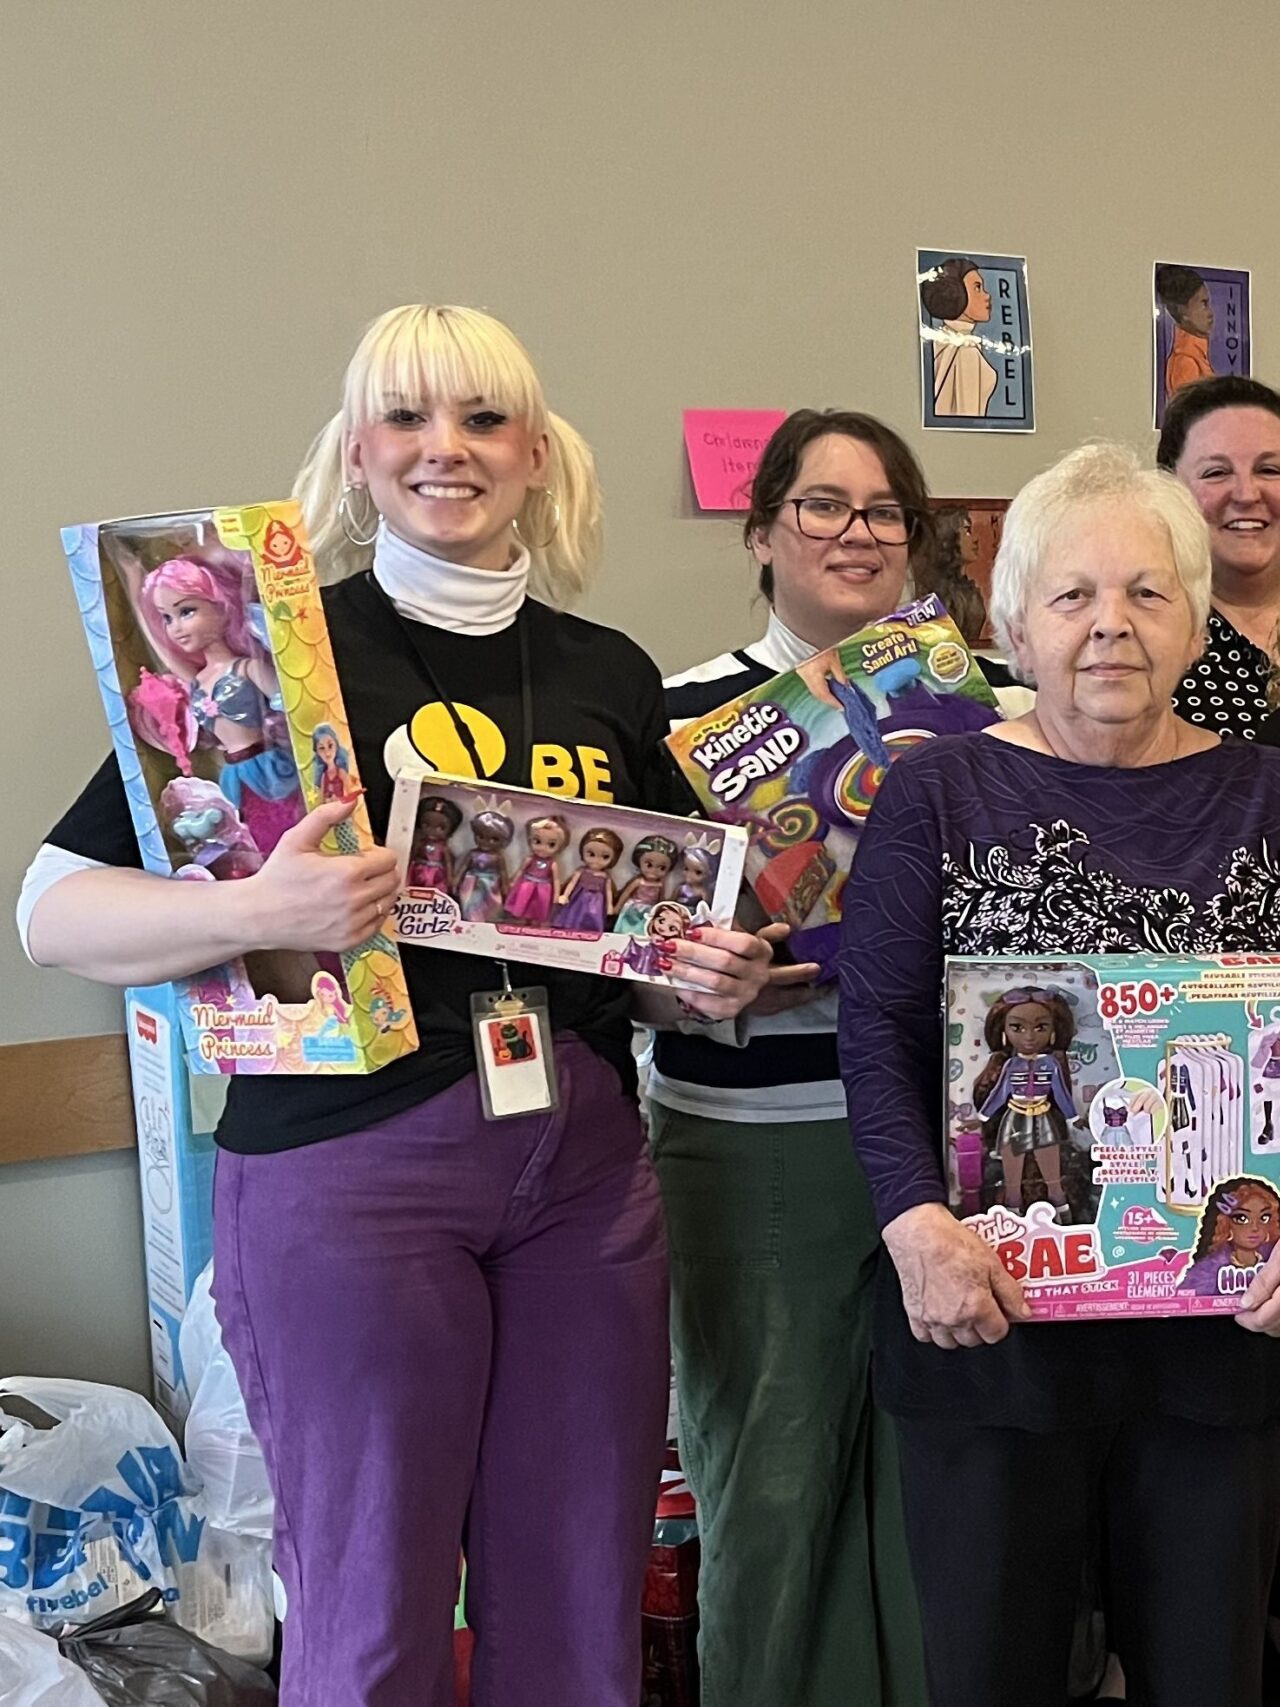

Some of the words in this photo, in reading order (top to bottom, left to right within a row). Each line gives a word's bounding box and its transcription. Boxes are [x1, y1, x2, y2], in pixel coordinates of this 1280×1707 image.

[998, 278, 1016, 406] REBEL
[861, 633, 905, 658] Create
[861, 650, 894, 674] Sand
[693, 705, 779, 770] Kinetic
[531, 744, 613, 804] BE
[1100, 982, 1175, 1018] 850+
[193, 1002, 276, 1028] Mermaid
[201, 1033, 274, 1061] Princess
[1127, 1211, 1153, 1225] 15+
[997, 1233, 1096, 1280] BAE
[1045, 1285, 1079, 1296] THAT
[1083, 1282, 1117, 1293] STICK
[1144, 1270, 1175, 1285] PIECES
